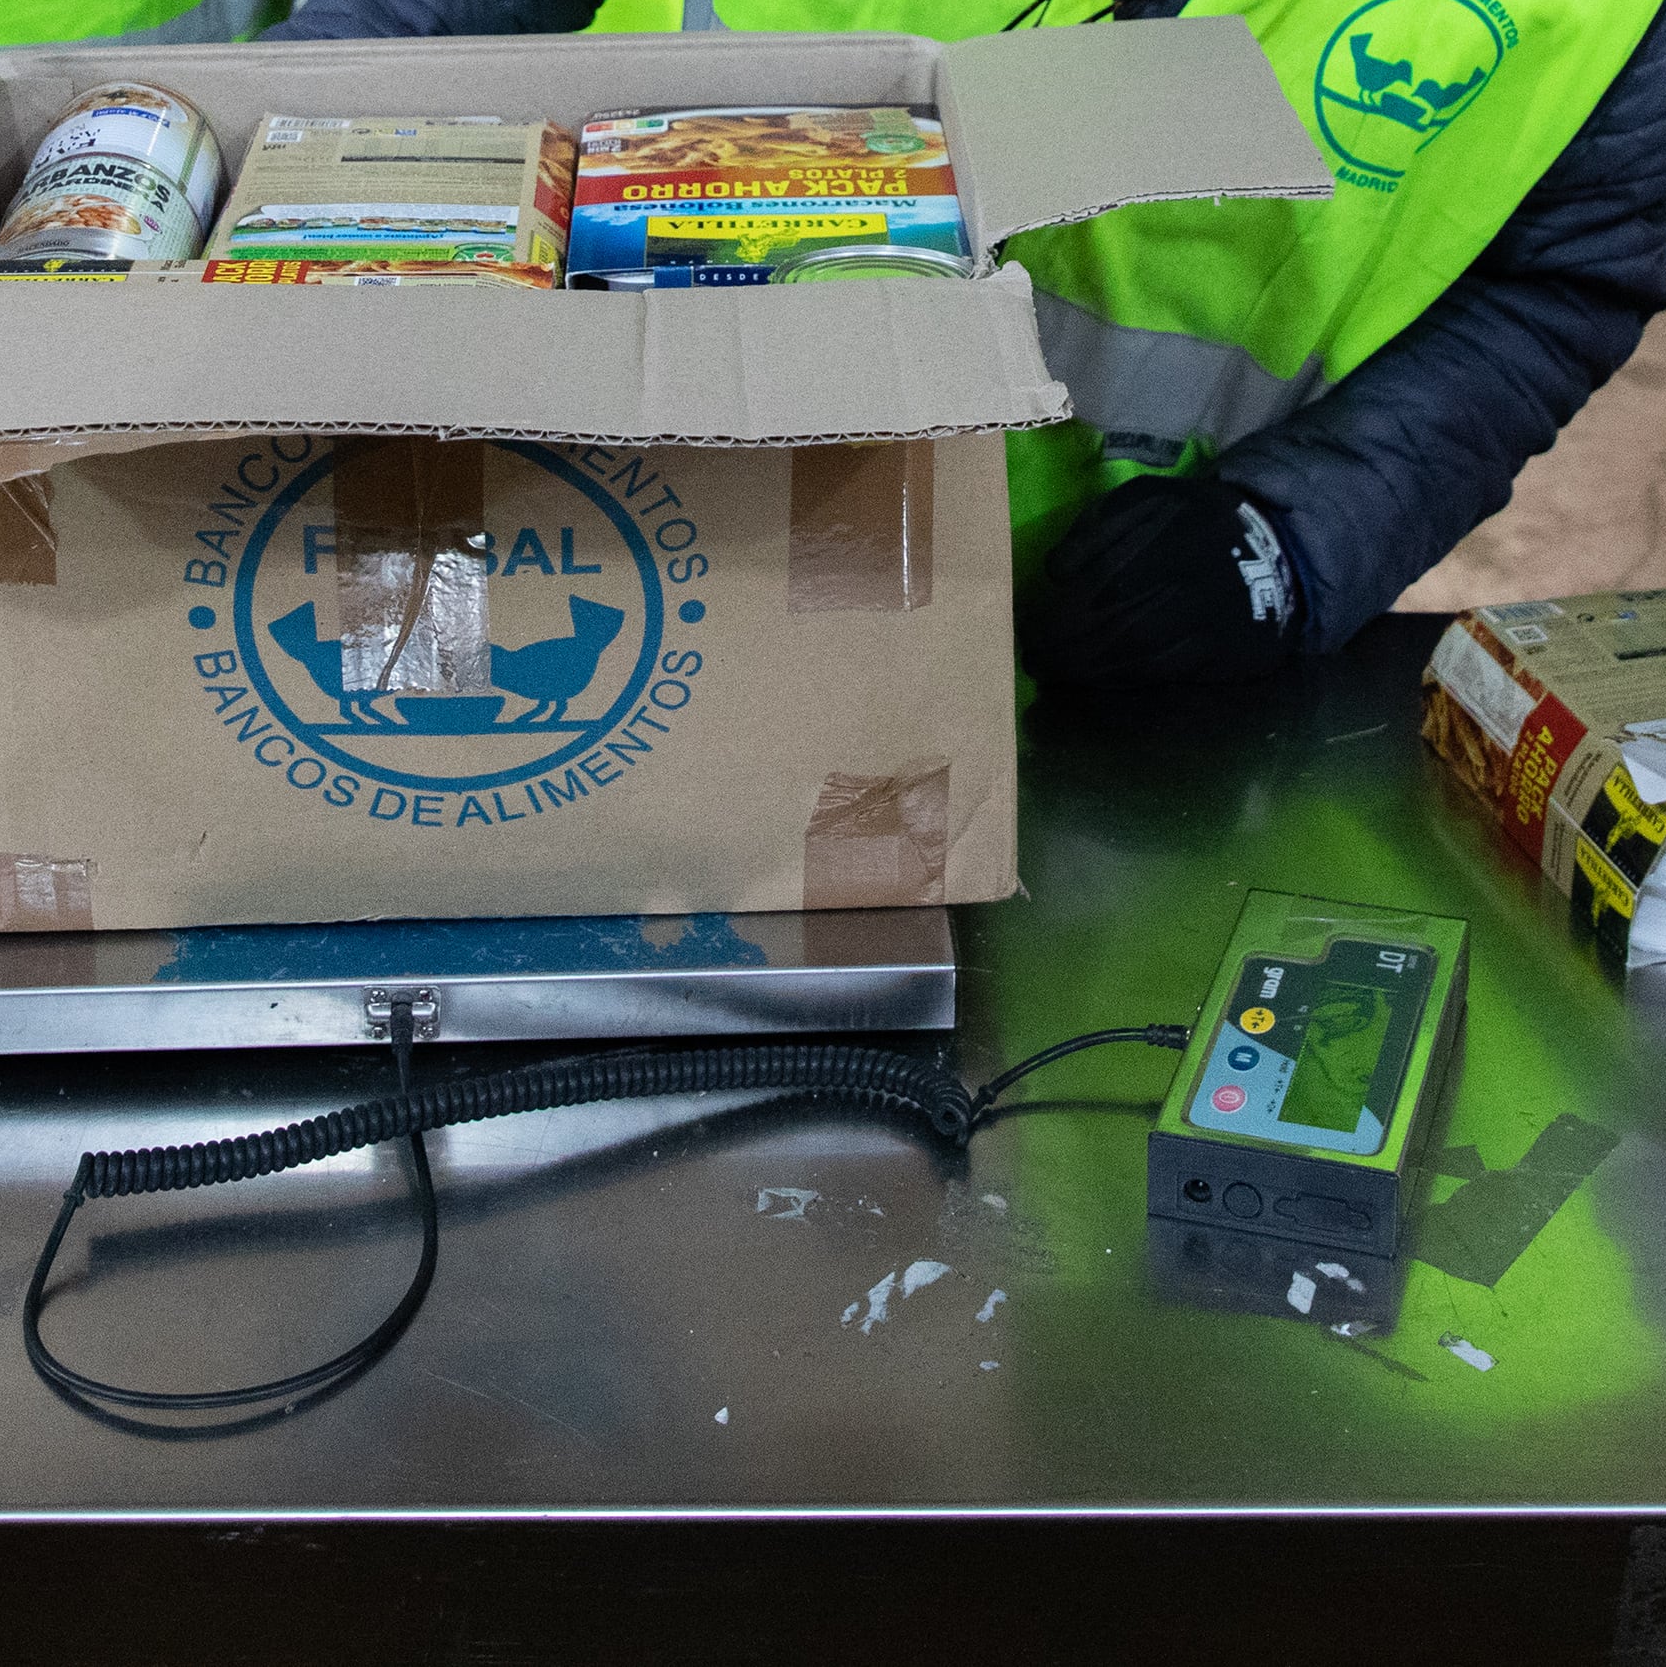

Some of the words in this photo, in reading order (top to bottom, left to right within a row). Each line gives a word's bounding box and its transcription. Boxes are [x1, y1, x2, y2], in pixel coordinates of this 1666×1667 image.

[788, 168, 885, 180] PLATOS
[1335, 165, 1399, 193] MADRID
[621, 180, 790, 200] AHORRO
[799, 179, 909, 196] PACK
[750, 199, 918, 211] Macarrones
[667, 217, 869, 230] CARRETILLA
[213, 260, 248, 283] ACK
[698, 271, 760, 283] DESDE
[193, 649, 362, 809] BANCOS
[368, 787, 445, 828] DE
[455, 648, 705, 828] ALIMENTOS
[1376, 950, 1407, 974] DT
[1259, 966, 1285, 1000] gram
